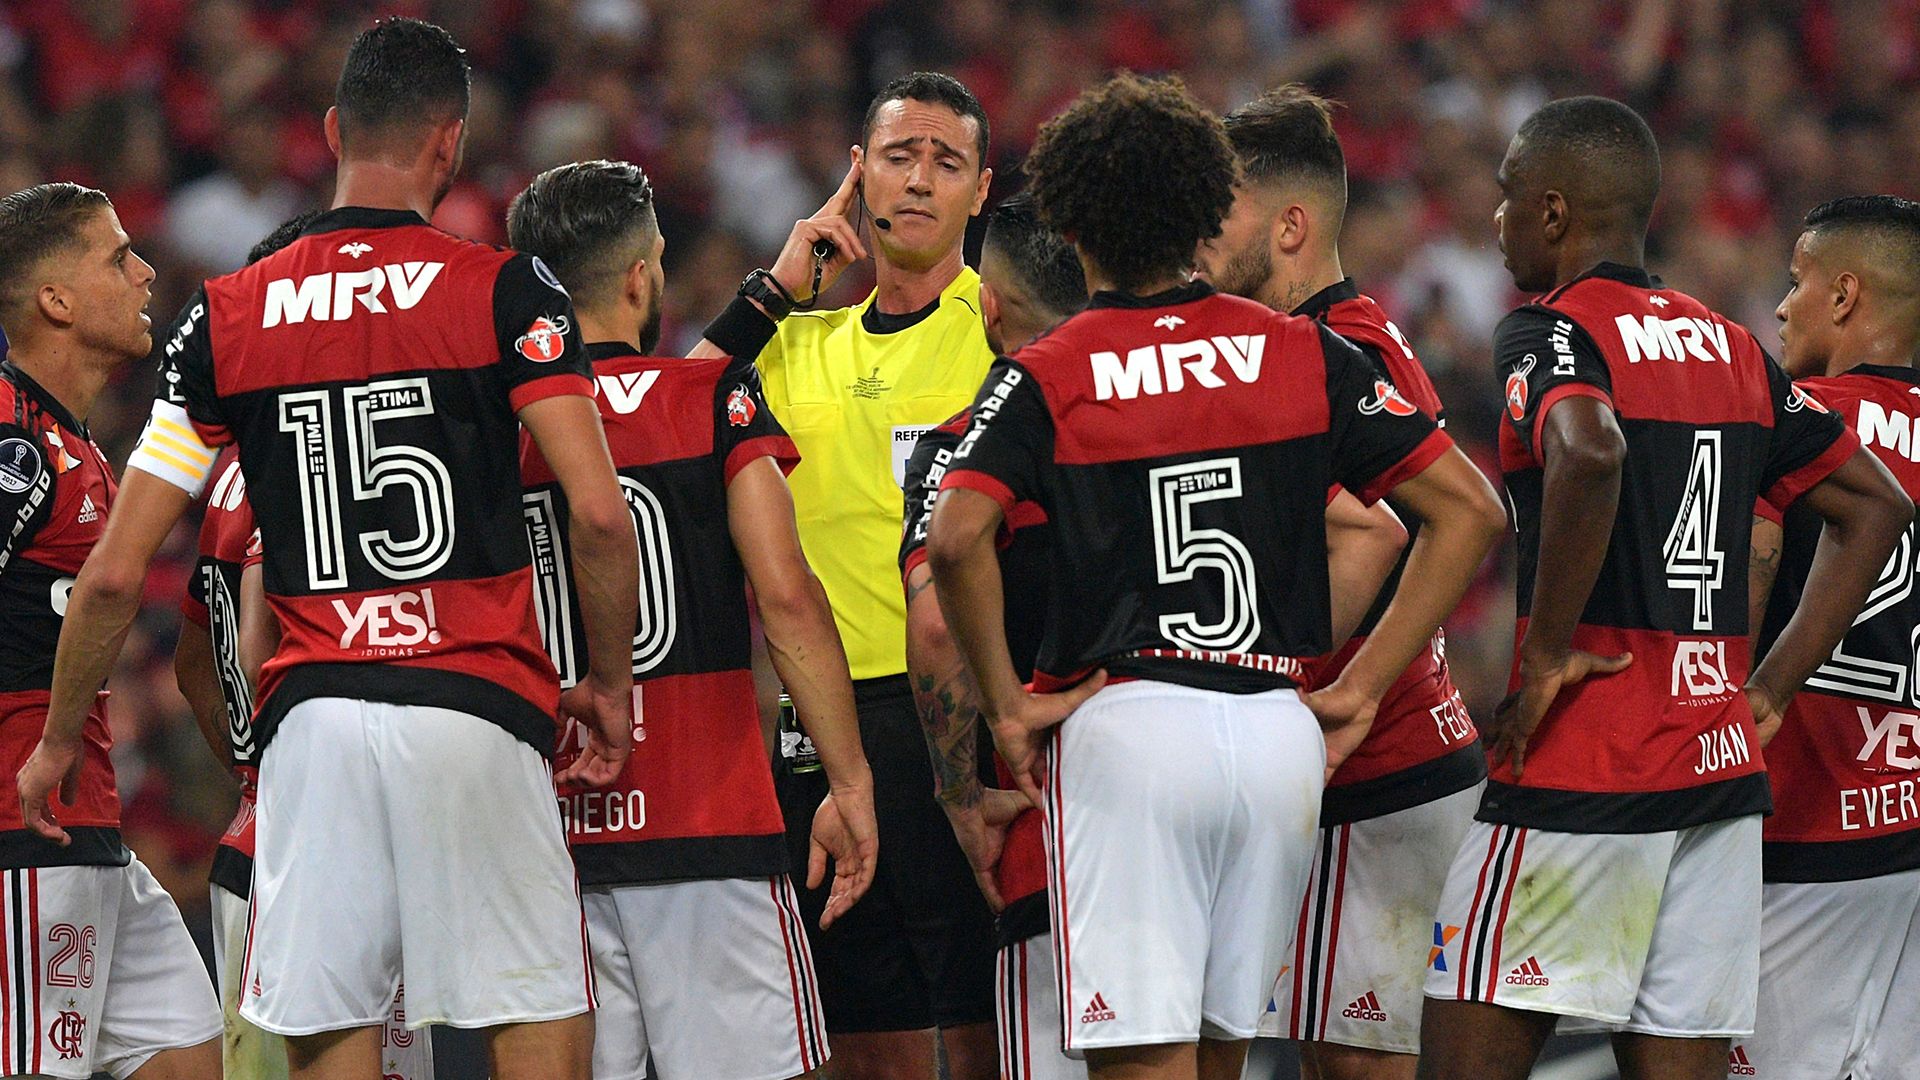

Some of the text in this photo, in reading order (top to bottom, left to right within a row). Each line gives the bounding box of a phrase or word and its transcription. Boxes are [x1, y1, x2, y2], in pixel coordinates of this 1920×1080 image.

[262, 262, 445, 328] MRV
[1615, 313, 1731, 364] MRV
[1090, 334, 1266, 401] MRV
[378, 390, 411, 407] TIM
[306, 424, 322, 455] TIM
[2, 474, 17, 486] 2017
[278, 377, 455, 590] 15
[0, 469, 50, 575] arabao
[1663, 430, 1725, 630] 4
[1149, 457, 1261, 653] 5
[331, 588, 441, 649] YES!
[361, 648, 413, 656] IDIOMAS
[1694, 722, 1749, 775] JUAN
[1856, 706, 1920, 770] YE
[1840, 777, 1920, 831] EVER
[47, 923, 96, 988] 26
[1505, 974, 1549, 987] adidas
[1081, 1011, 1116, 1024] adidas
[1342, 1007, 1386, 1022] adidas
